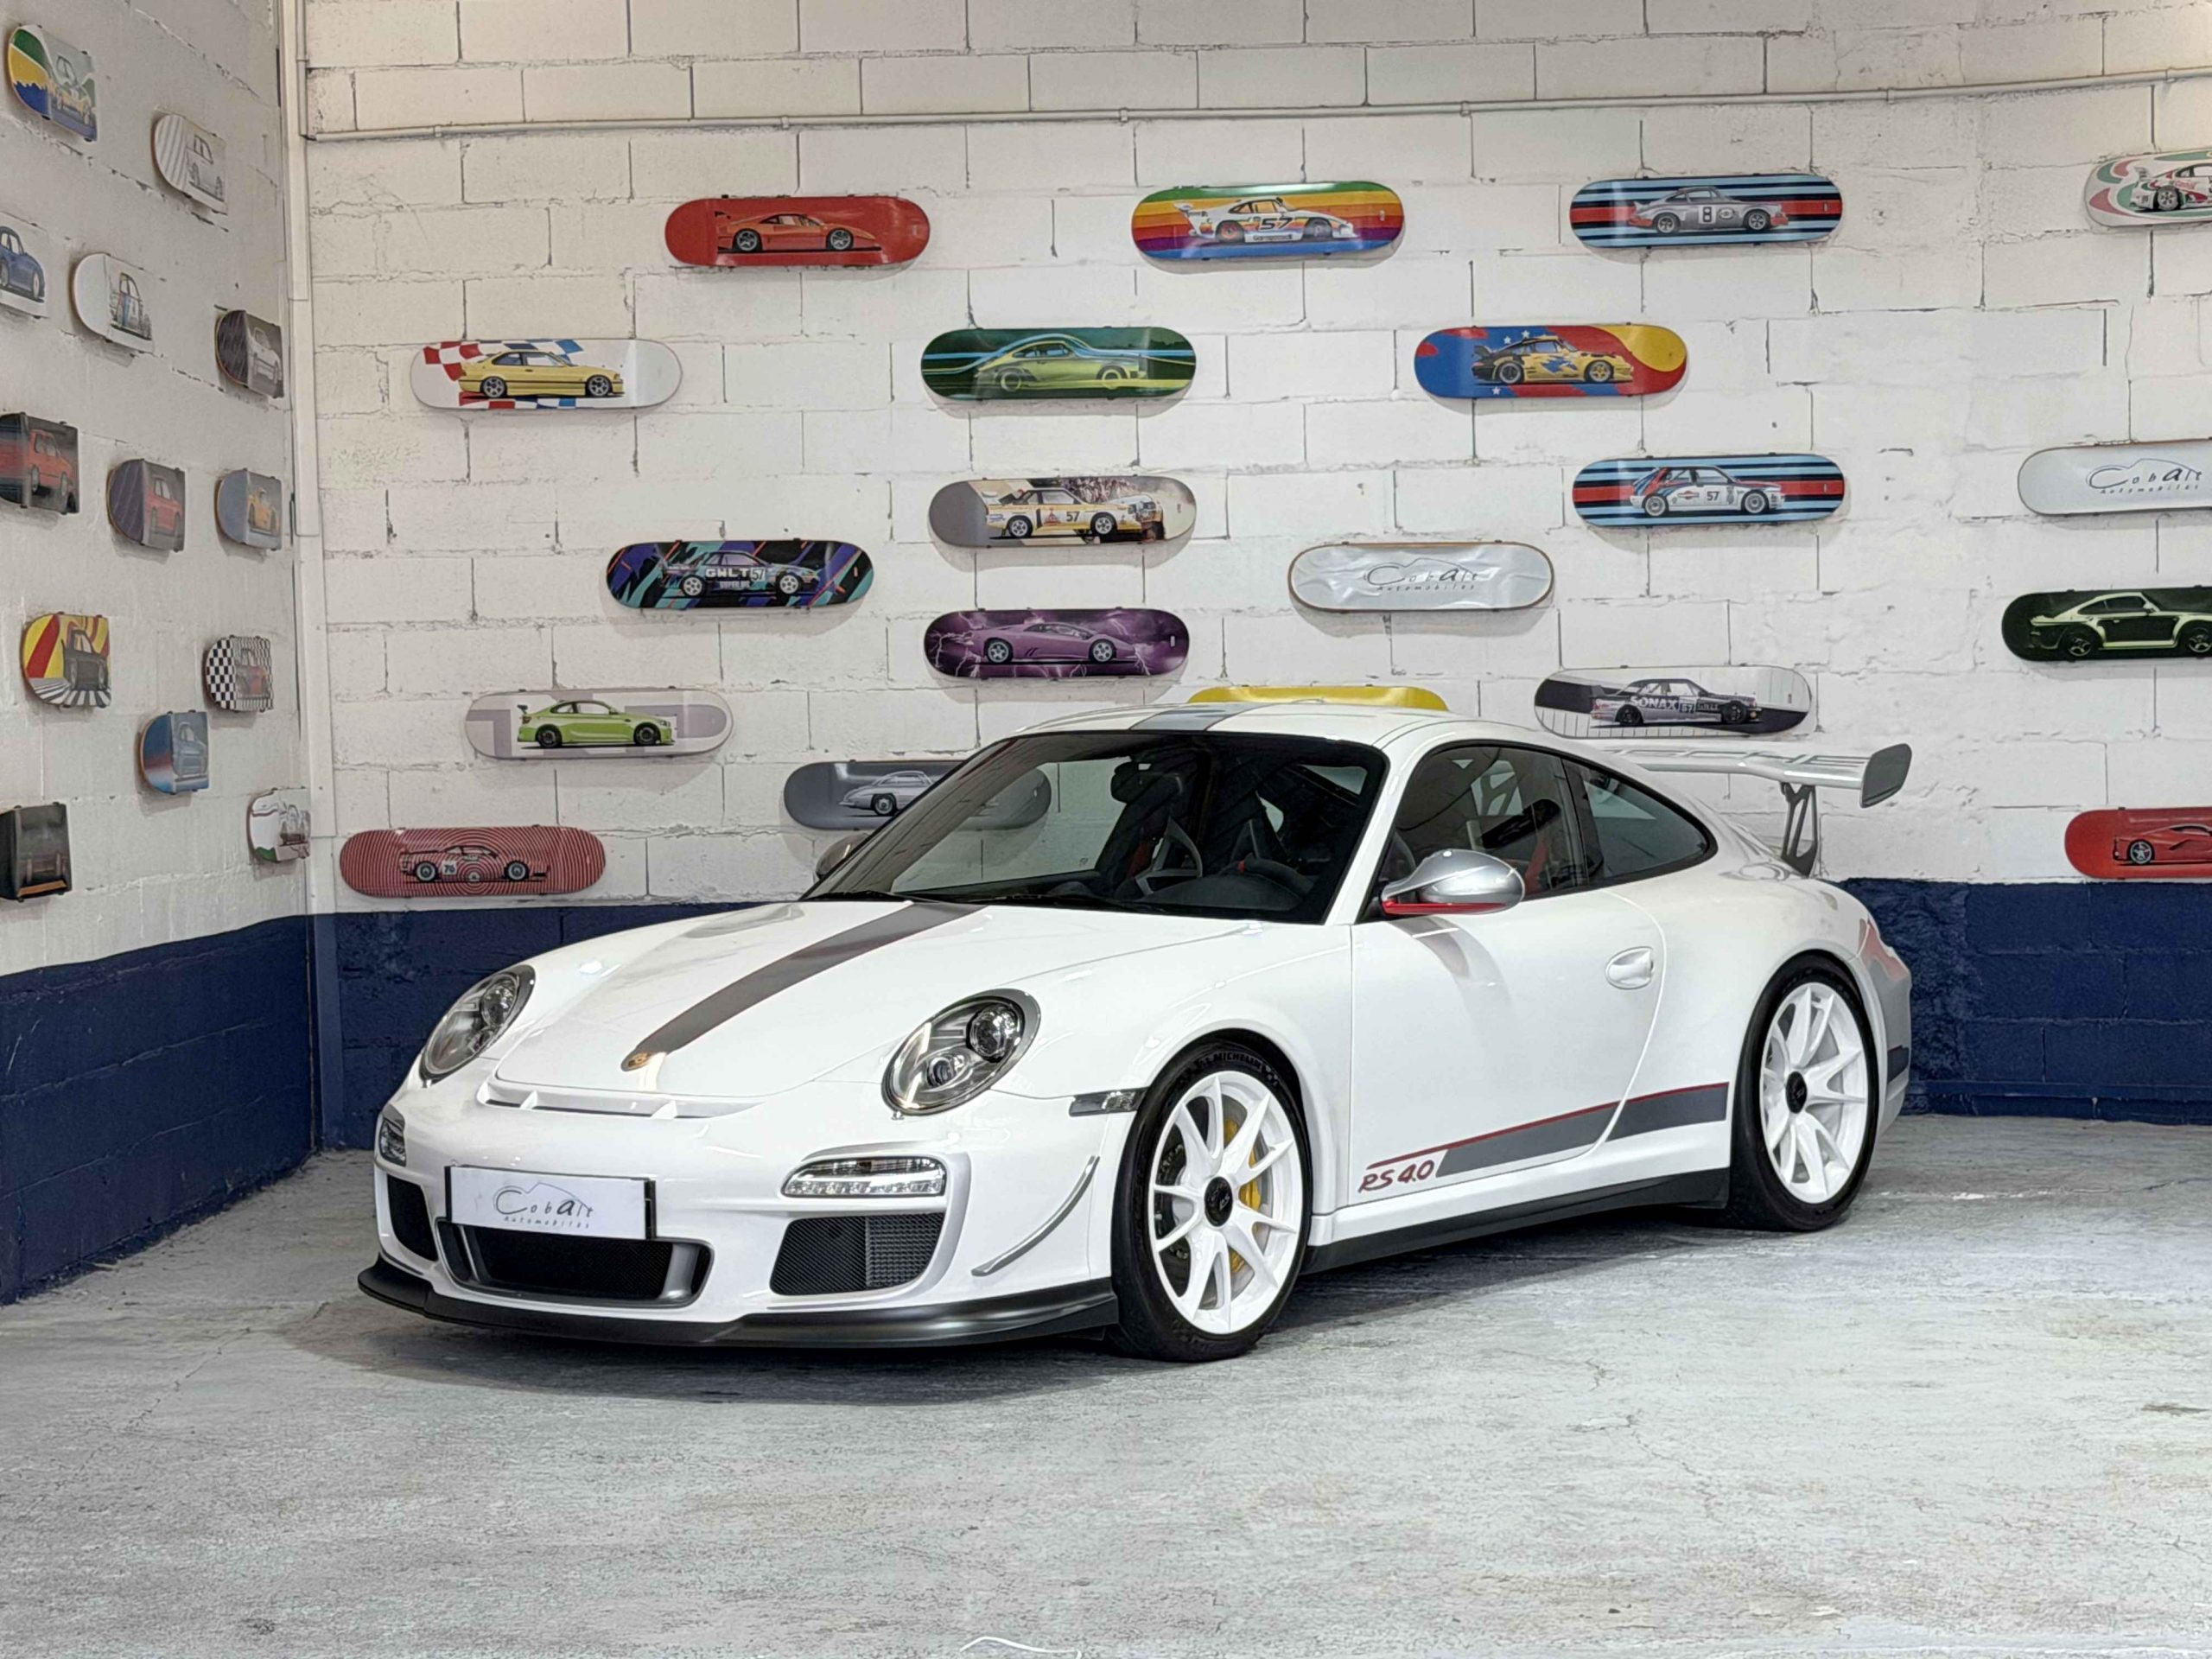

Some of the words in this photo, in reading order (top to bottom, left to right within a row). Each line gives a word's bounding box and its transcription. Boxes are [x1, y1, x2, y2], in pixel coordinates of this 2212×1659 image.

[1702, 206, 1713, 223] 8
[1260, 217, 1294, 231] 57
[2088, 467, 2202, 489] Cobalt
[1707, 491, 1719, 502] 57
[1065, 511, 1080, 523] 57
[752, 567, 765, 581] 57
[1630, 695, 1678, 711] SONAX
[1213, 1052, 1262, 1071] MICHELIN
[1357, 1168, 1395, 1193] RS
[1396, 1159, 1435, 1184] 4.0
[495, 1187, 594, 1217] Cobalt
[505, 1216, 589, 1229] Automobiles
